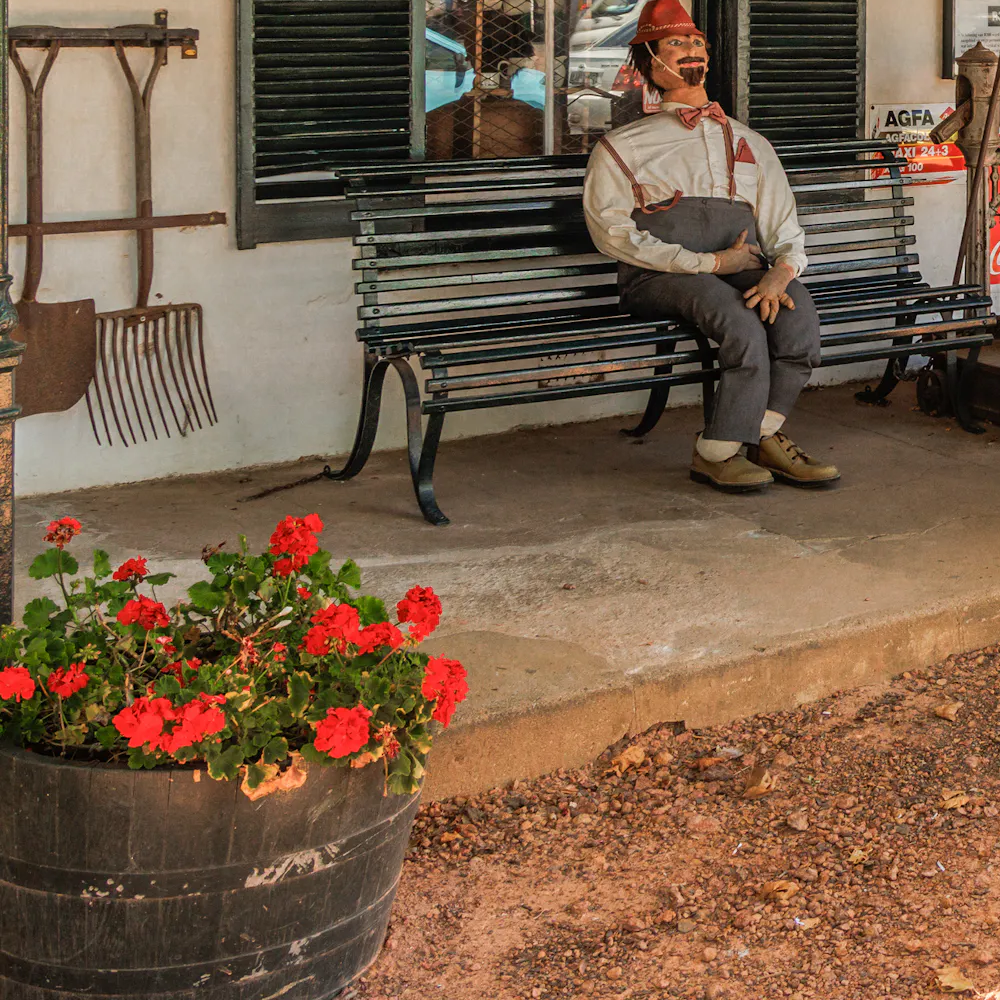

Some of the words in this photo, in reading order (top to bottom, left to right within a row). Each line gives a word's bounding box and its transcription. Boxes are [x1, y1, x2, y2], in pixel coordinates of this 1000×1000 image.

[884, 109, 935, 127] AGFA
[885, 131, 930, 143] AGFACOL
[893, 146, 917, 159] AXI
[920, 144, 949, 157] 24+3
[907, 162, 923, 172] 100
